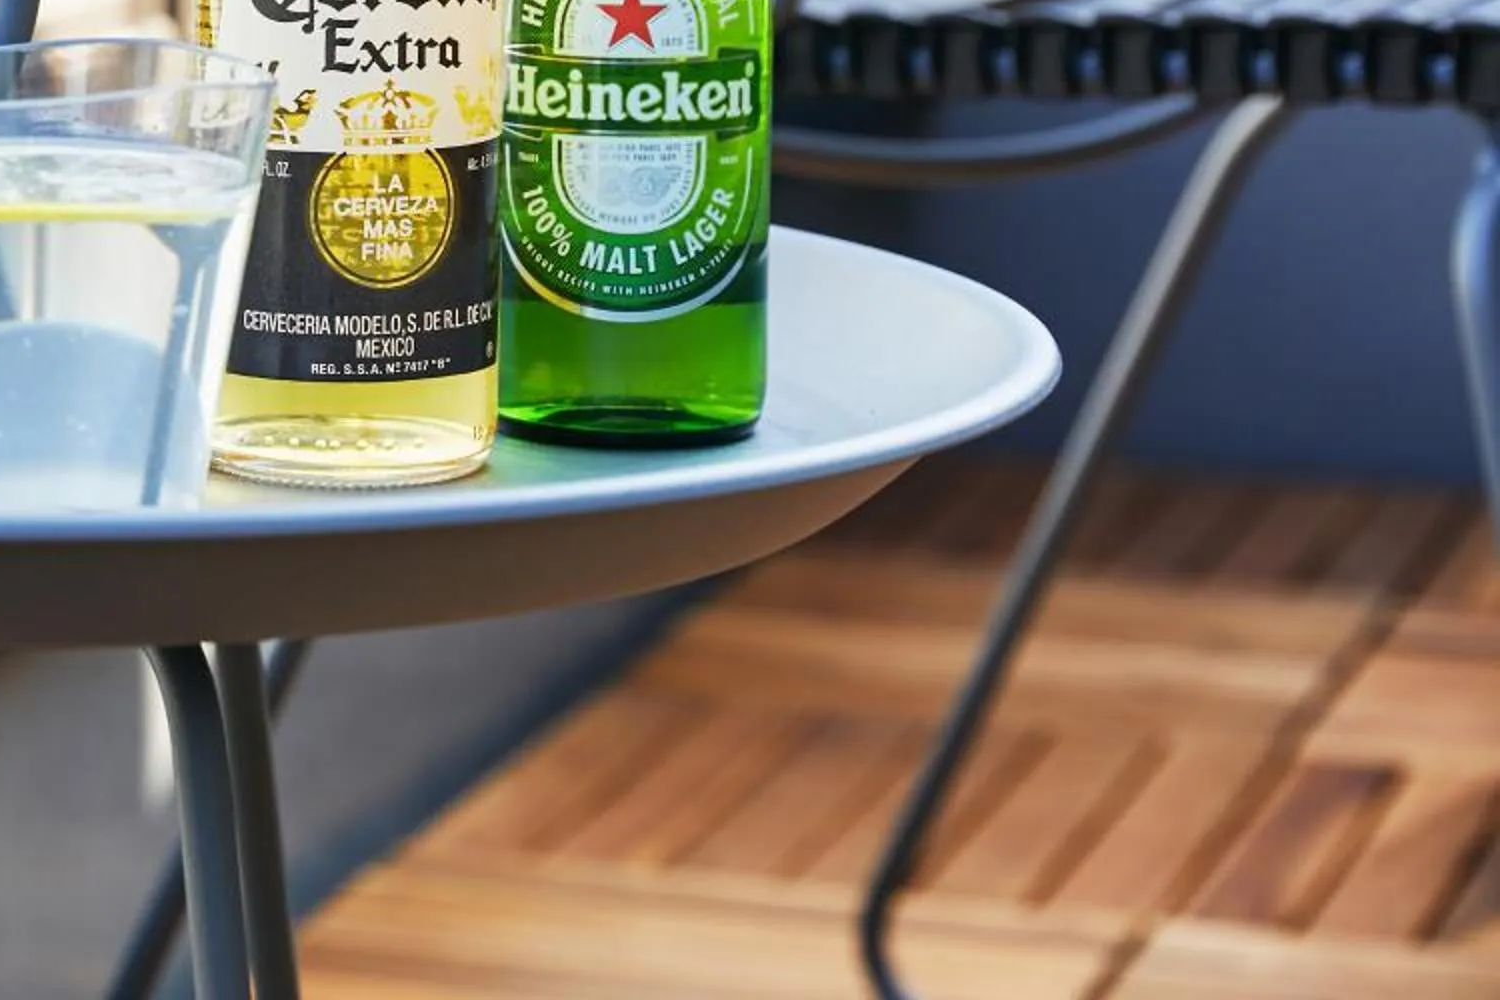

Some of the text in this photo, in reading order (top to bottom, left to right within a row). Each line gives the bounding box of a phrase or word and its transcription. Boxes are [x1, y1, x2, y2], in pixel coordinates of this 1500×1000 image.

[321, 17, 461, 74] Extra
[505, 61, 753, 122] Heineken
[373, 174, 404, 193] LA
[332, 196, 438, 216] CERVEZA
[363, 219, 413, 239] MAS
[522, 185, 736, 275] 100% MALT LAGER
[361, 242, 414, 261] FINA
[243, 308, 331, 335] CERVECERIA
[423, 310, 442, 332] DE
[355, 335, 415, 359] MEXICO
[311, 363, 341, 375] REG.
